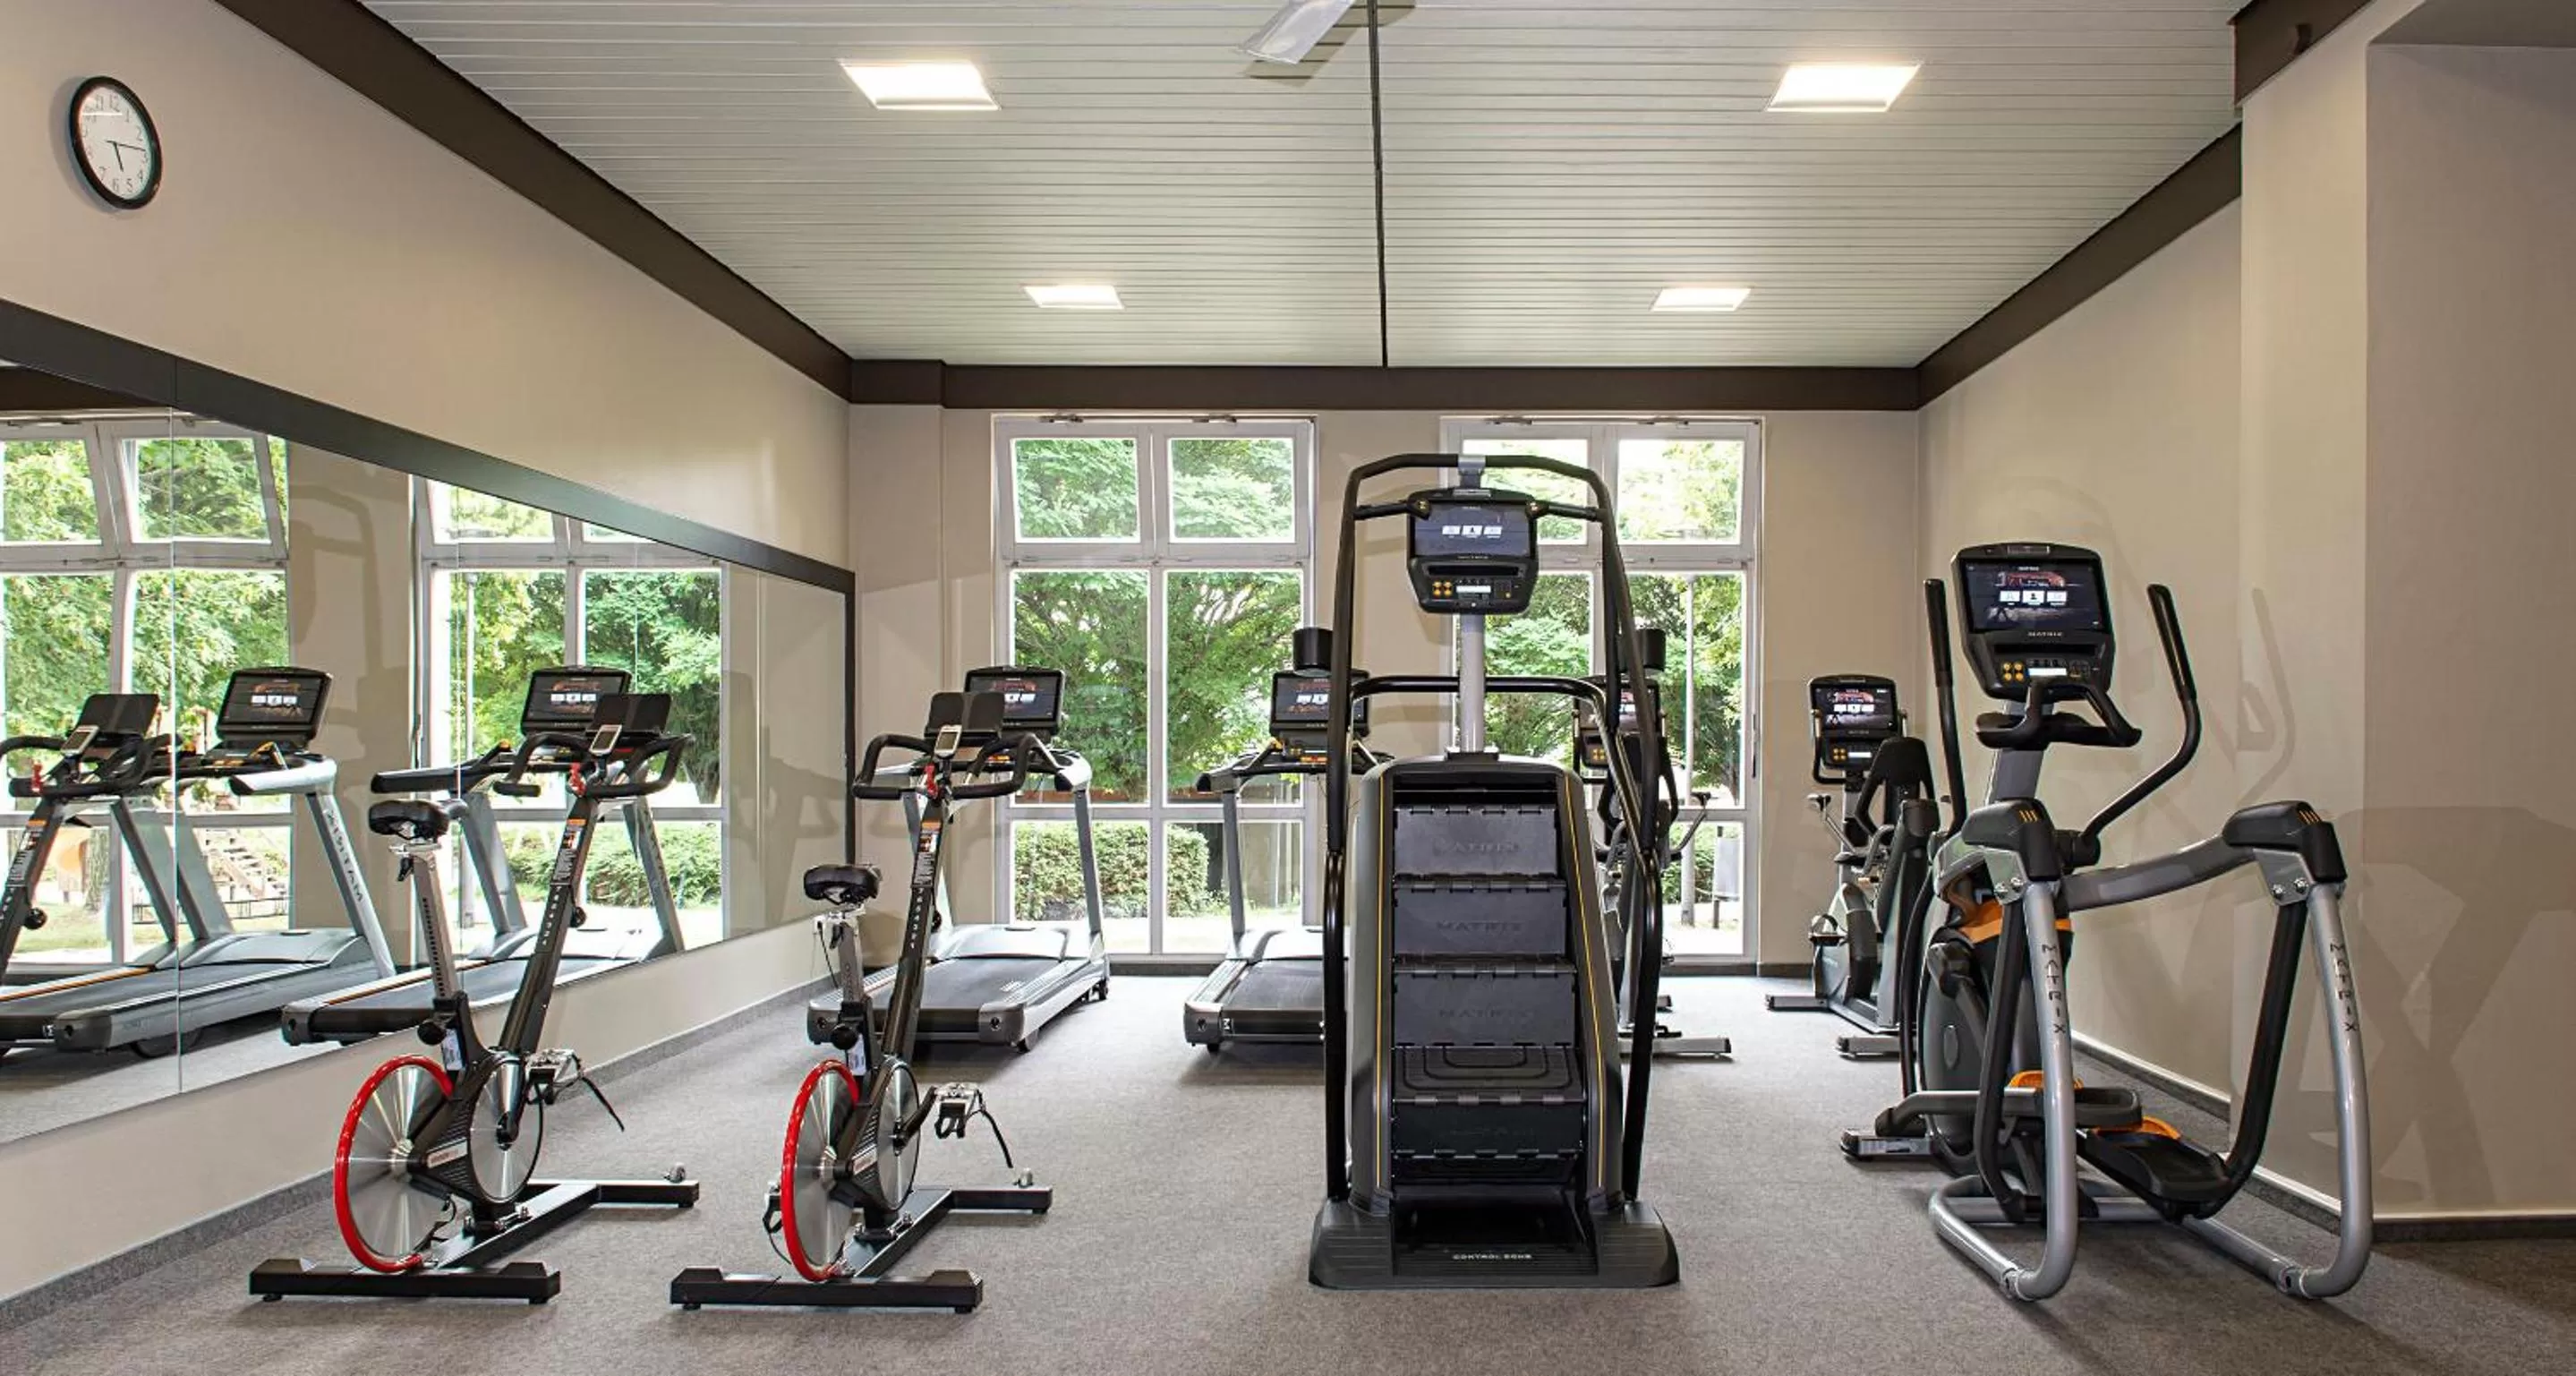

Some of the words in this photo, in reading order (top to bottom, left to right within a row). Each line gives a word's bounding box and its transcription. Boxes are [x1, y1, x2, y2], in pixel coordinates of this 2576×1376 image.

[136, 125, 143, 141] 2
[137, 169, 143, 184] 4
[1437, 920, 1523, 932] MATRIX
[2042, 944, 2067, 1035] MATRIX
[2330, 942, 2359, 1032] MATRIX
